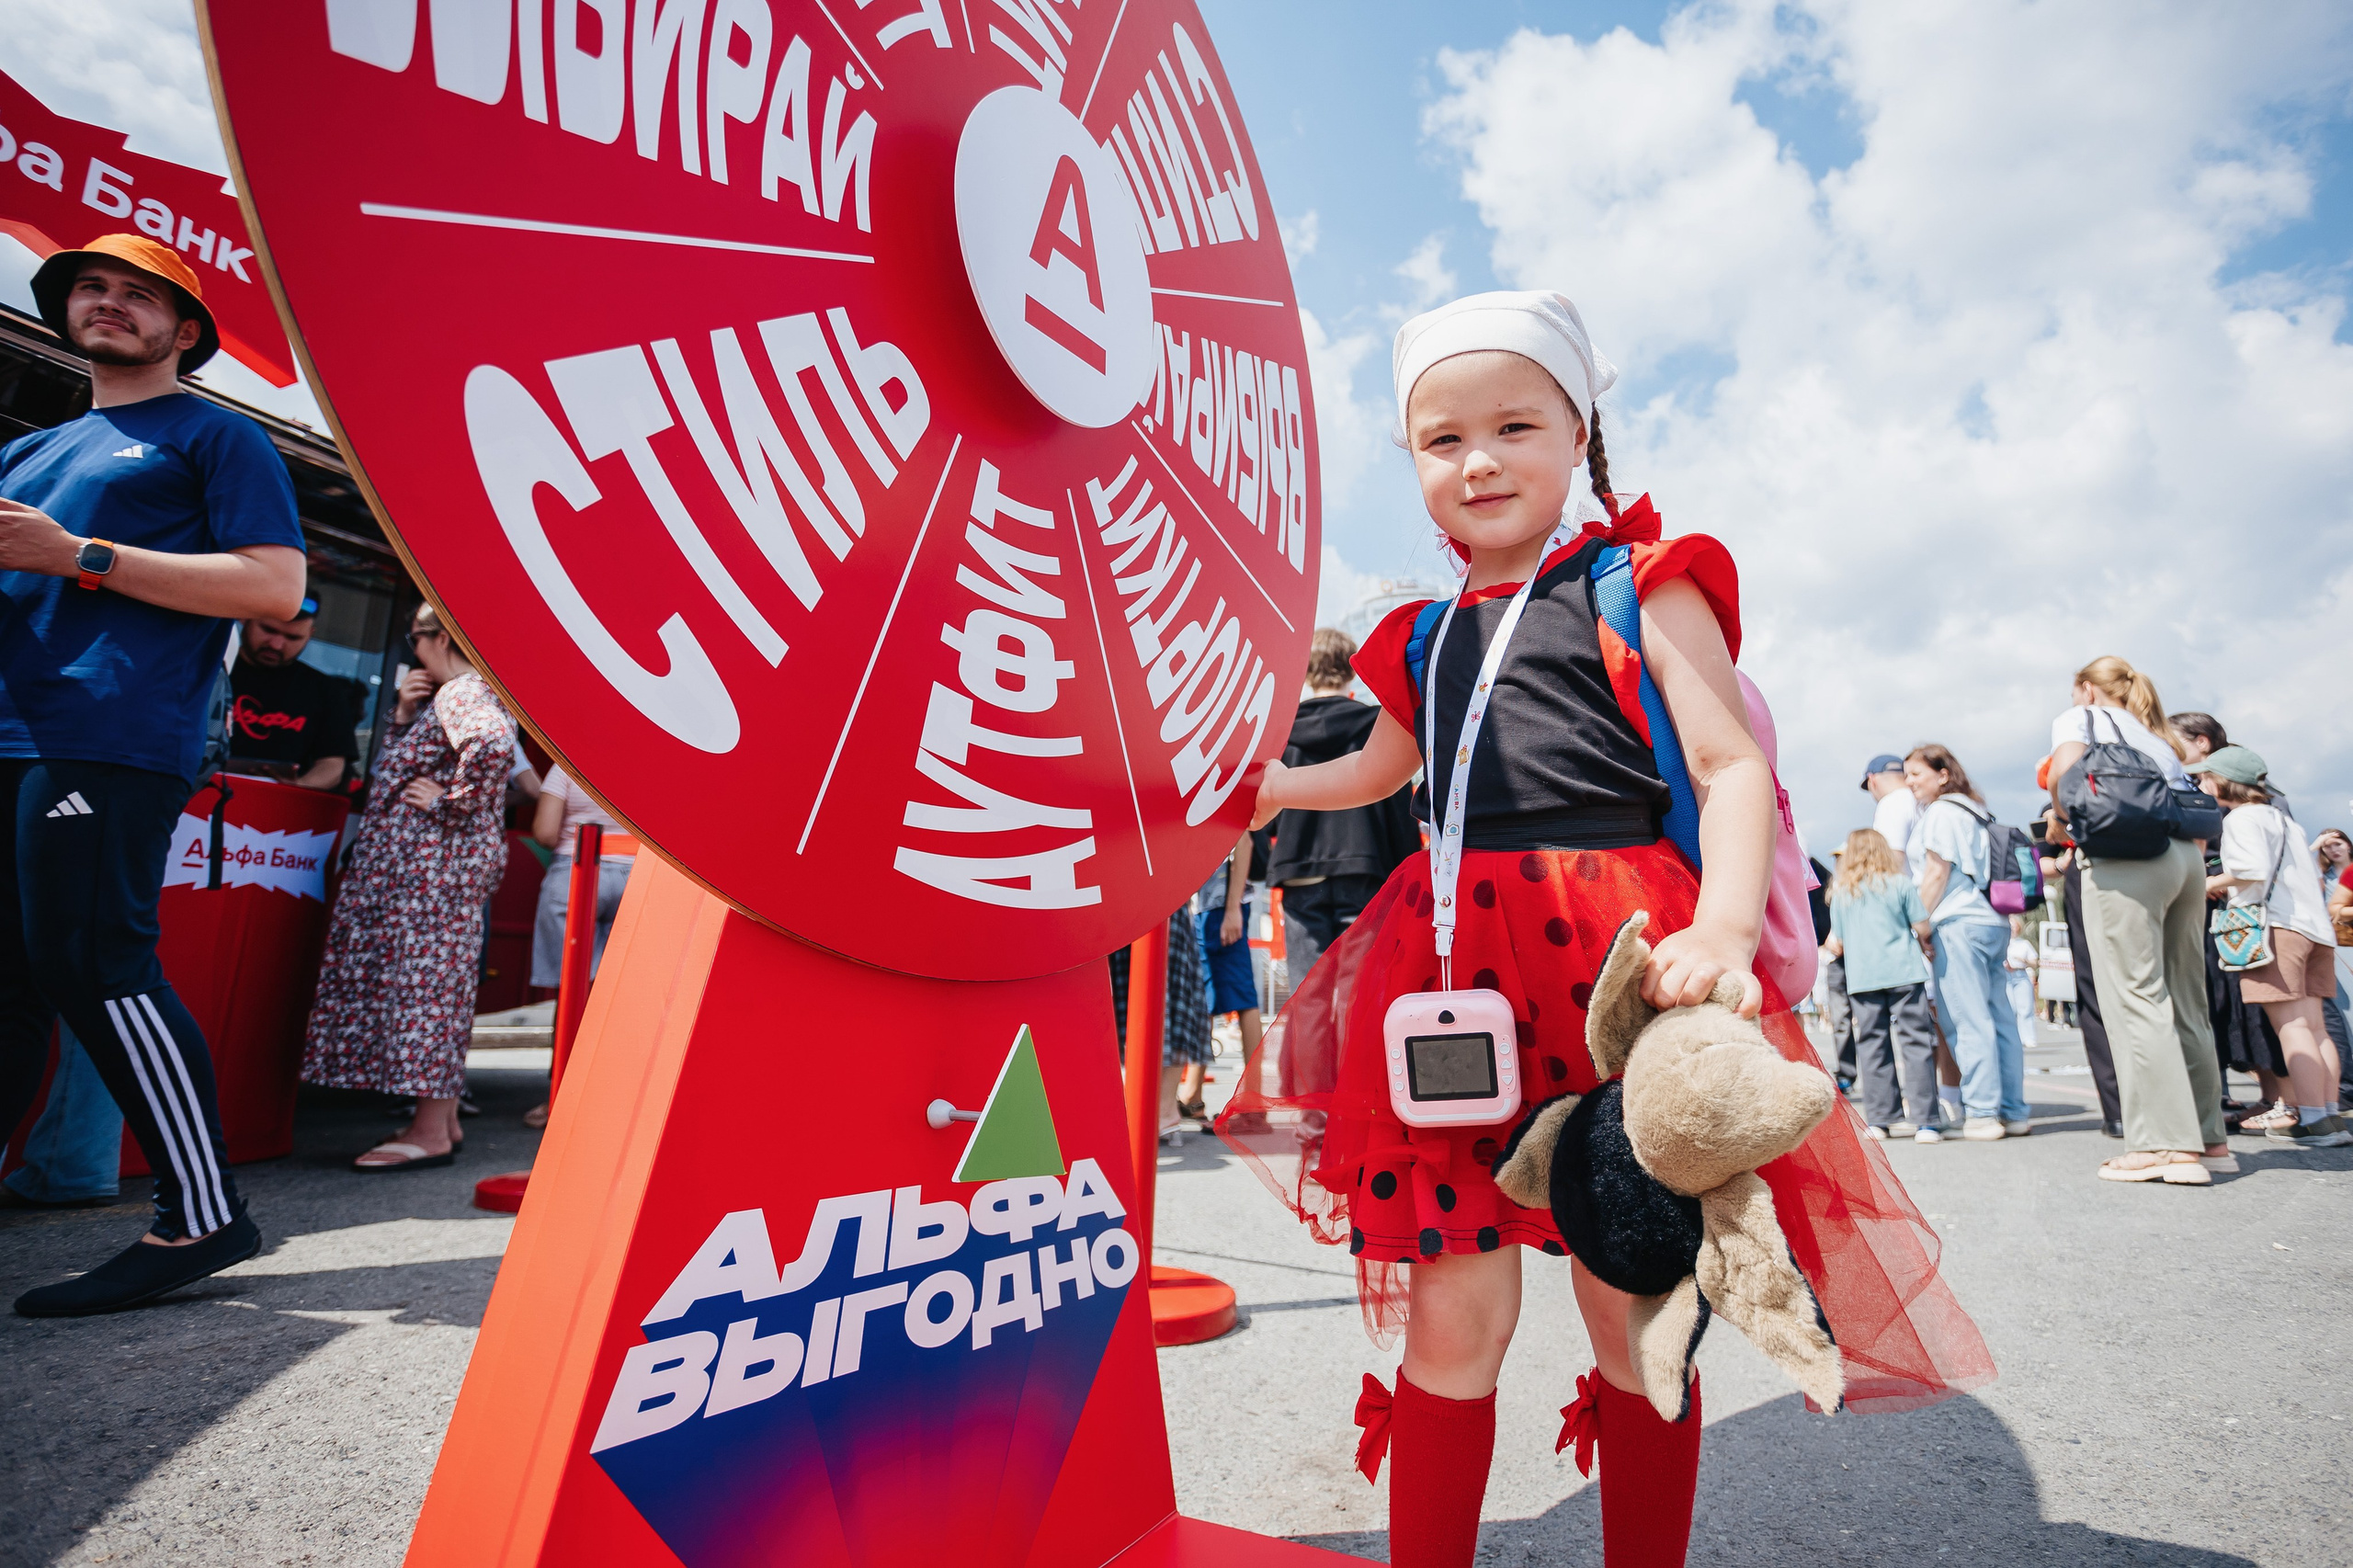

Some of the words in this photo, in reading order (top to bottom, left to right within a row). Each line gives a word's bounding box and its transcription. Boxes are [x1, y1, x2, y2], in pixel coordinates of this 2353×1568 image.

[81, 156, 255, 284] Банк
[464, 306, 930, 754] СТИЛЬ
[1137, 321, 1307, 575] ВЫБИРАЙ
[893, 458, 1102, 910] АУТФИТ
[1086, 454, 1276, 827] СПОРТКИТ
[183, 837, 266, 869] Аьфа
[270, 846, 319, 872] Банк
[589, 1228, 1140, 1455] ВЫГОДНО
[640, 1158, 1127, 1327] АЛЬФА
